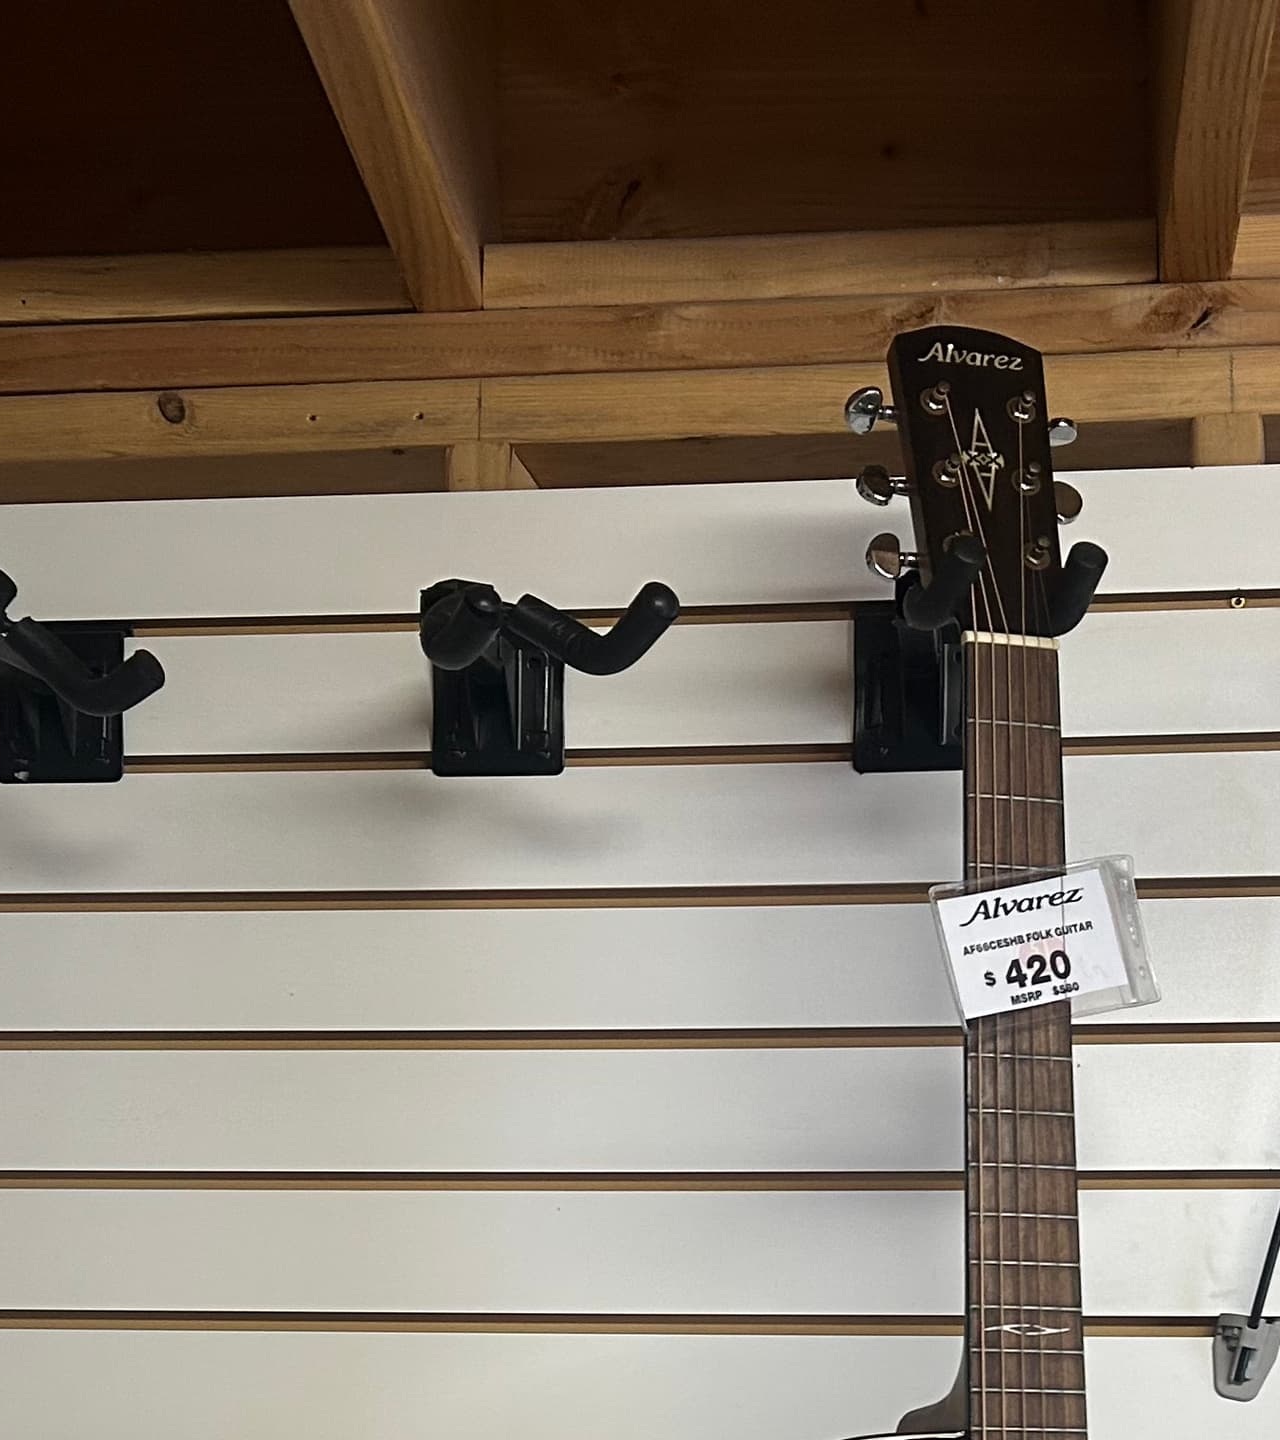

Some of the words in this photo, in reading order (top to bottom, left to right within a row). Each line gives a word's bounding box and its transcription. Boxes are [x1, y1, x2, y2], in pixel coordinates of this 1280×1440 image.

[917, 342, 1024, 371] Alvarez
[959, 888, 1084, 927] Alvarez
[1025, 929, 1053, 943] FOLK
[1054, 920, 1094, 937] GUITAR
[983, 971, 997, 987] $
[1005, 950, 1072, 988] 420
[1010, 990, 1042, 1005] MSRP
